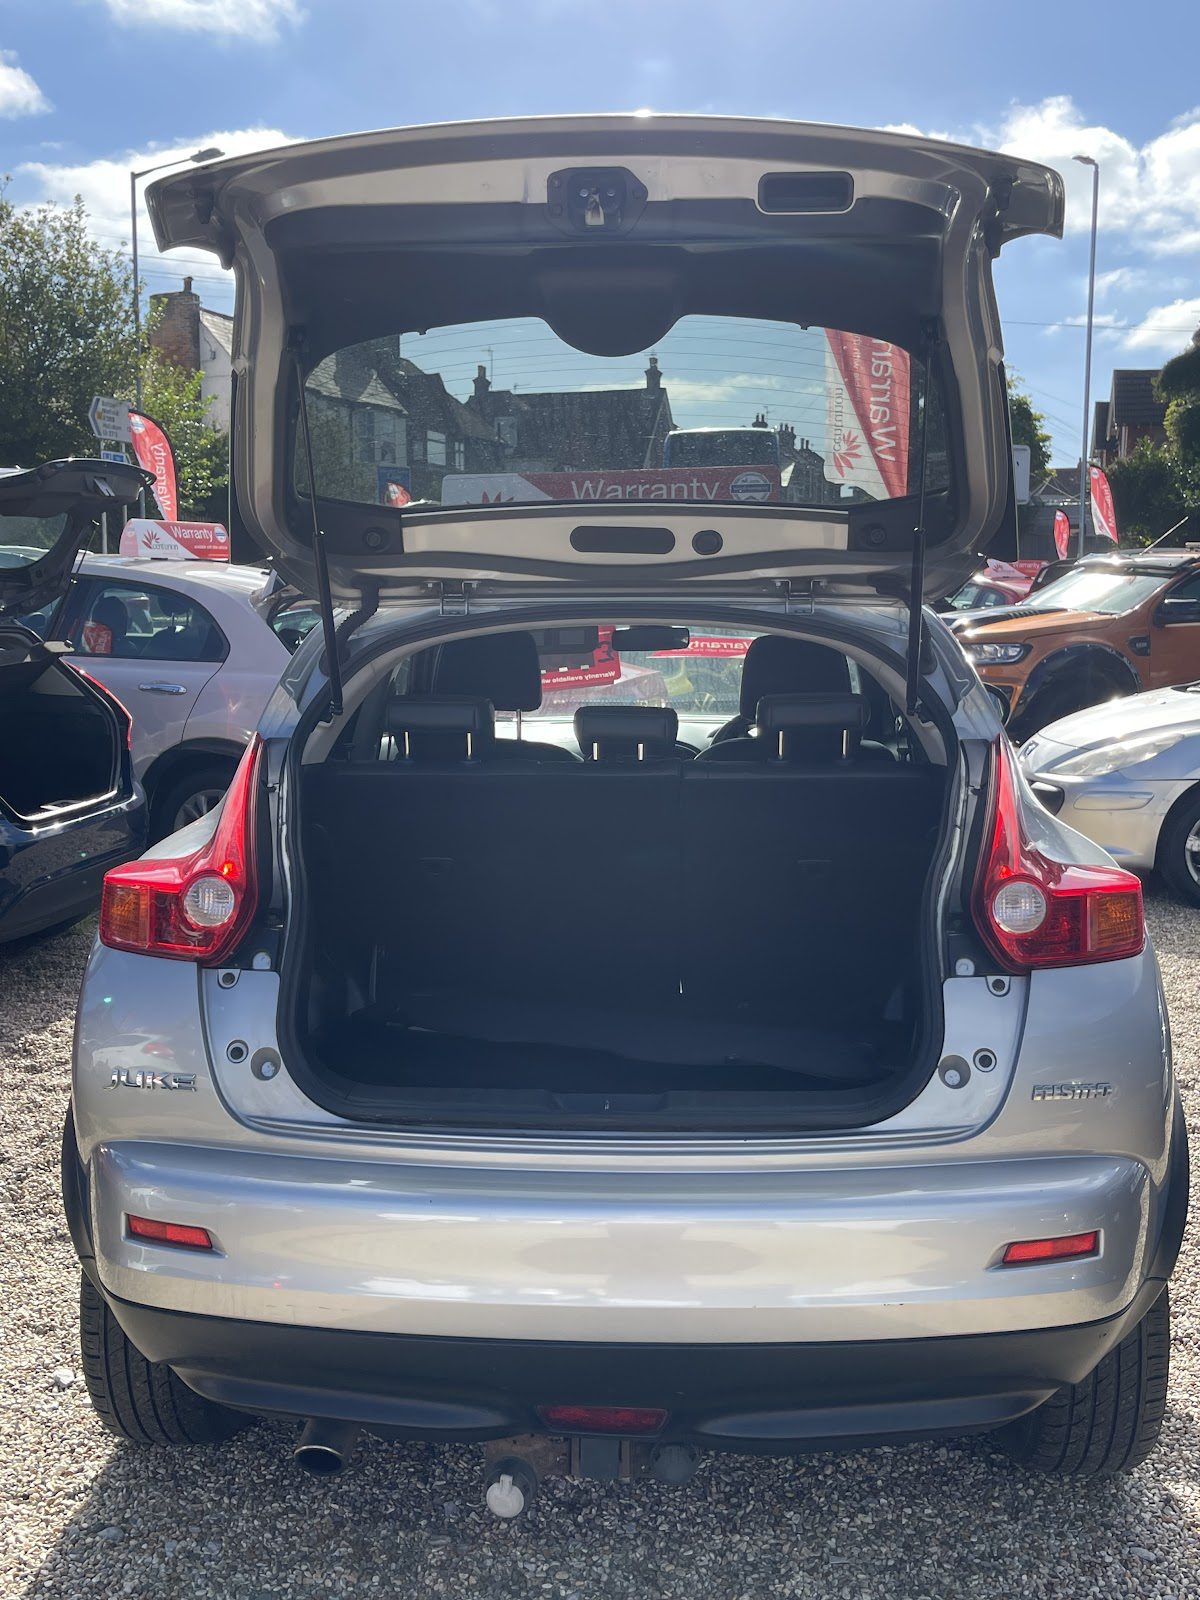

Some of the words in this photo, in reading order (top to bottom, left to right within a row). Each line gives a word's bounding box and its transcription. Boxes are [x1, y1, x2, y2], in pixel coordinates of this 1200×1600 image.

[572, 478, 720, 500] Warranty
[170, 525, 213, 543] Warranty
[104, 1069, 197, 1092] JUKE
